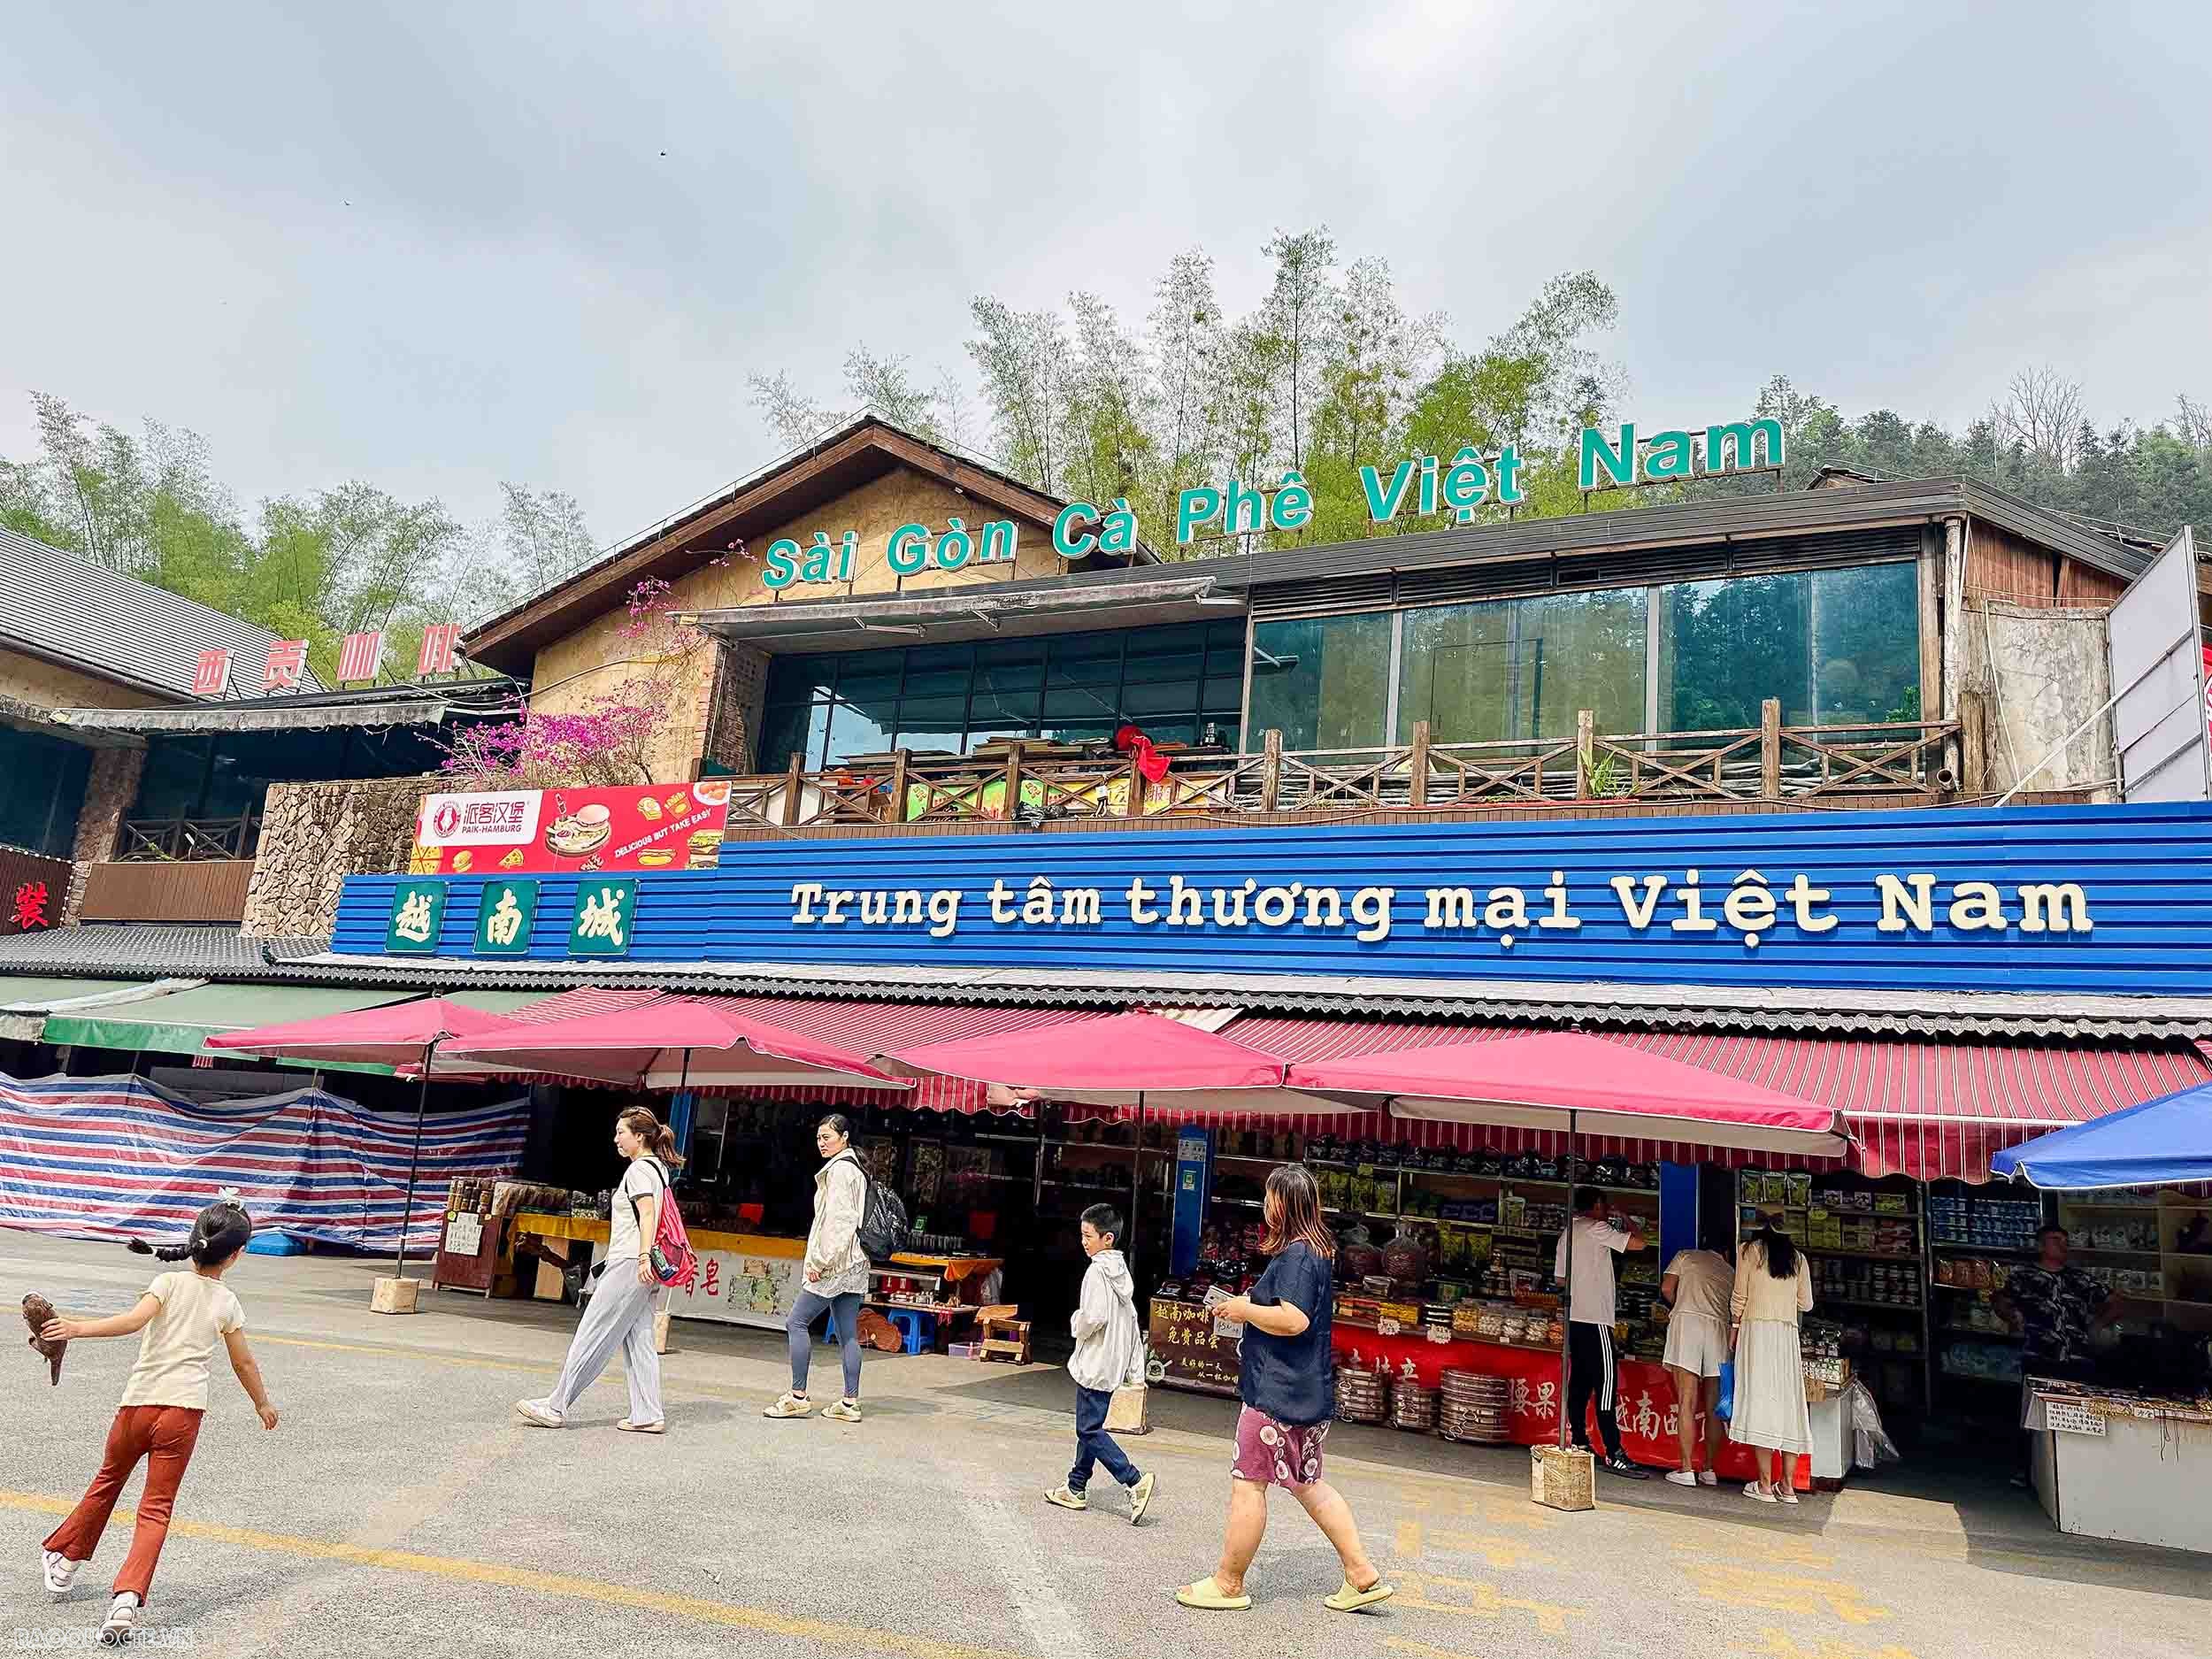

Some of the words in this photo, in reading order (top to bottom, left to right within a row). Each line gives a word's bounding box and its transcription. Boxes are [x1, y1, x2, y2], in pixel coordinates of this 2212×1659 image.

[762, 531, 860, 590] Sài
[886, 517, 1018, 576] Gòn
[1051, 497, 1139, 559] Cà
[1176, 469, 1315, 544] Phê
[1358, 445, 1527, 525] Việt
[1578, 418, 1786, 490] Nam
[461, 824, 523, 833] PAIK-HAMBURG
[463, 801, 526, 825] 派客汉堡
[614, 834, 654, 858] DELICIOUS
[653, 826, 669, 841] BUT
[669, 816, 691, 833] TAKE
[690, 807, 712, 825] EASY
[395, 887, 626, 947] 越南城
[790, 883, 963, 936] Trung
[987, 875, 1103, 926] tâm
[1125, 875, 1395, 942] thương
[1423, 871, 1582, 948] mại
[1608, 869, 1839, 948] Việt
[1874, 872, 2093, 933] Nam
[1154, 1302, 1210, 1325] 越南咖啡
[1508, 1377, 1557, 1421] 腰果
